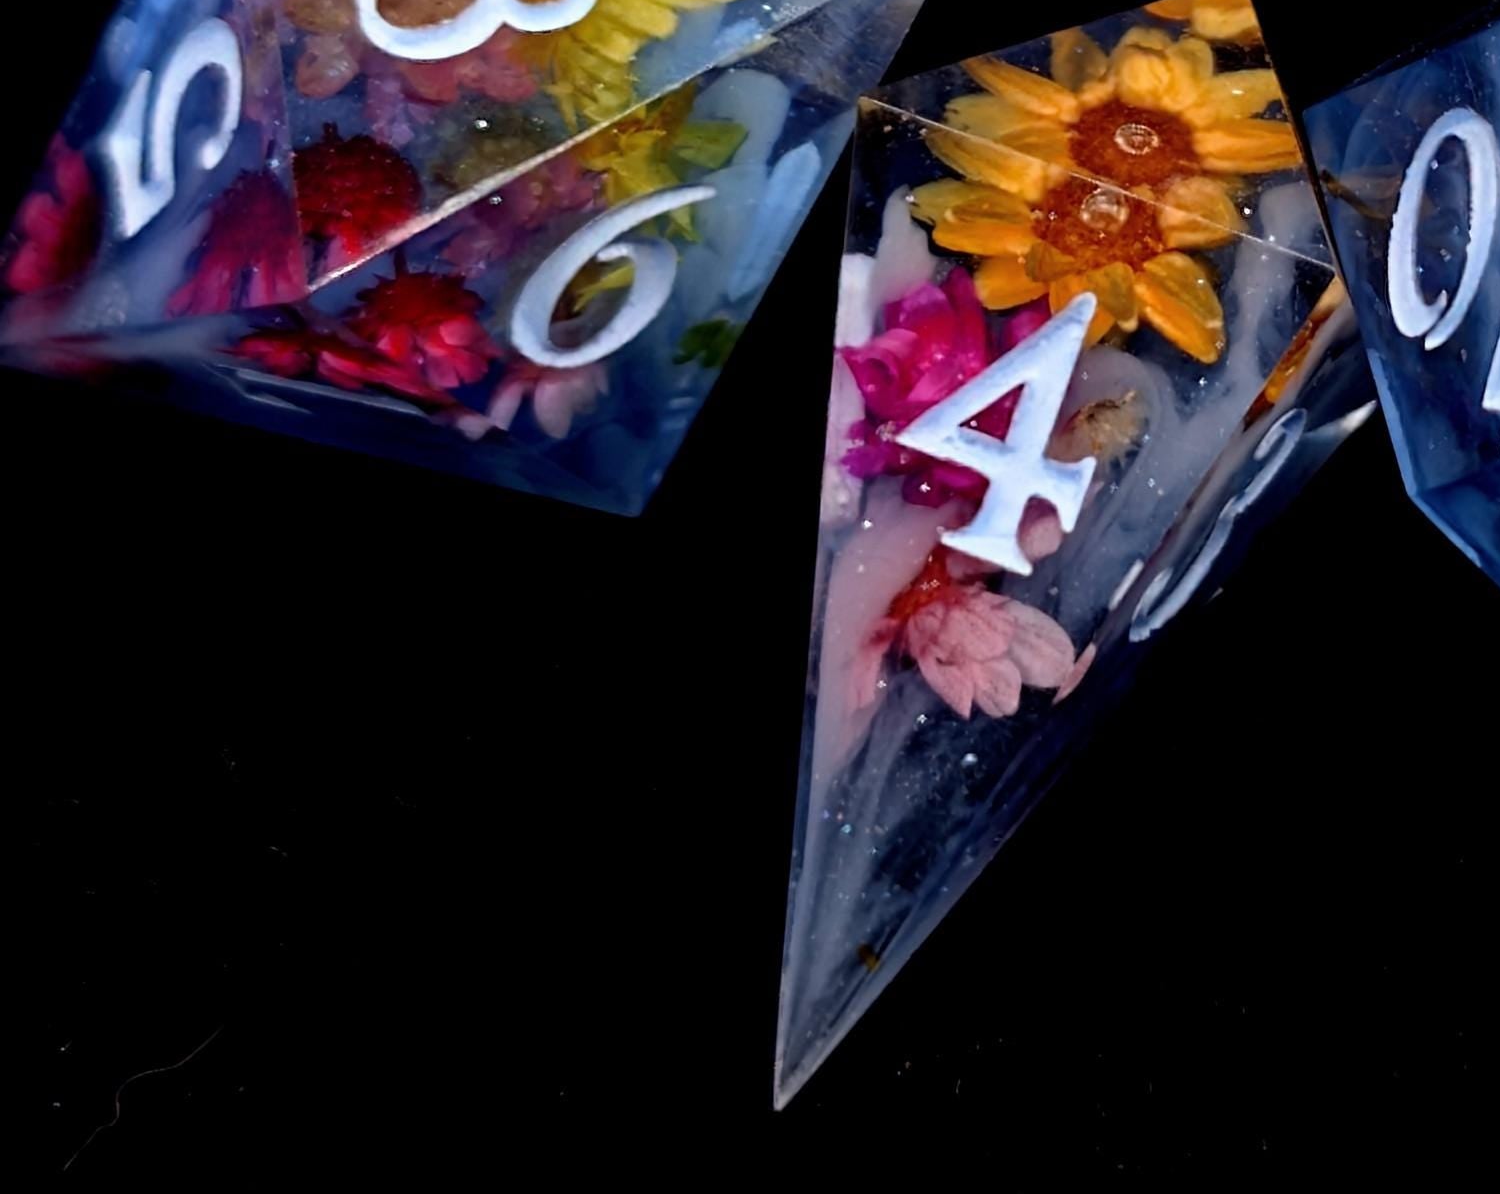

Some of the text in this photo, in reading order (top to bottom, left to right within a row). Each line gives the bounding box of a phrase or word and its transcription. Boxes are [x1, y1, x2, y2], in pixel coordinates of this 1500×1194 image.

[100, 15, 243, 239] 5
[510, 184, 718, 369] 6
[893, 290, 1098, 577] 4
